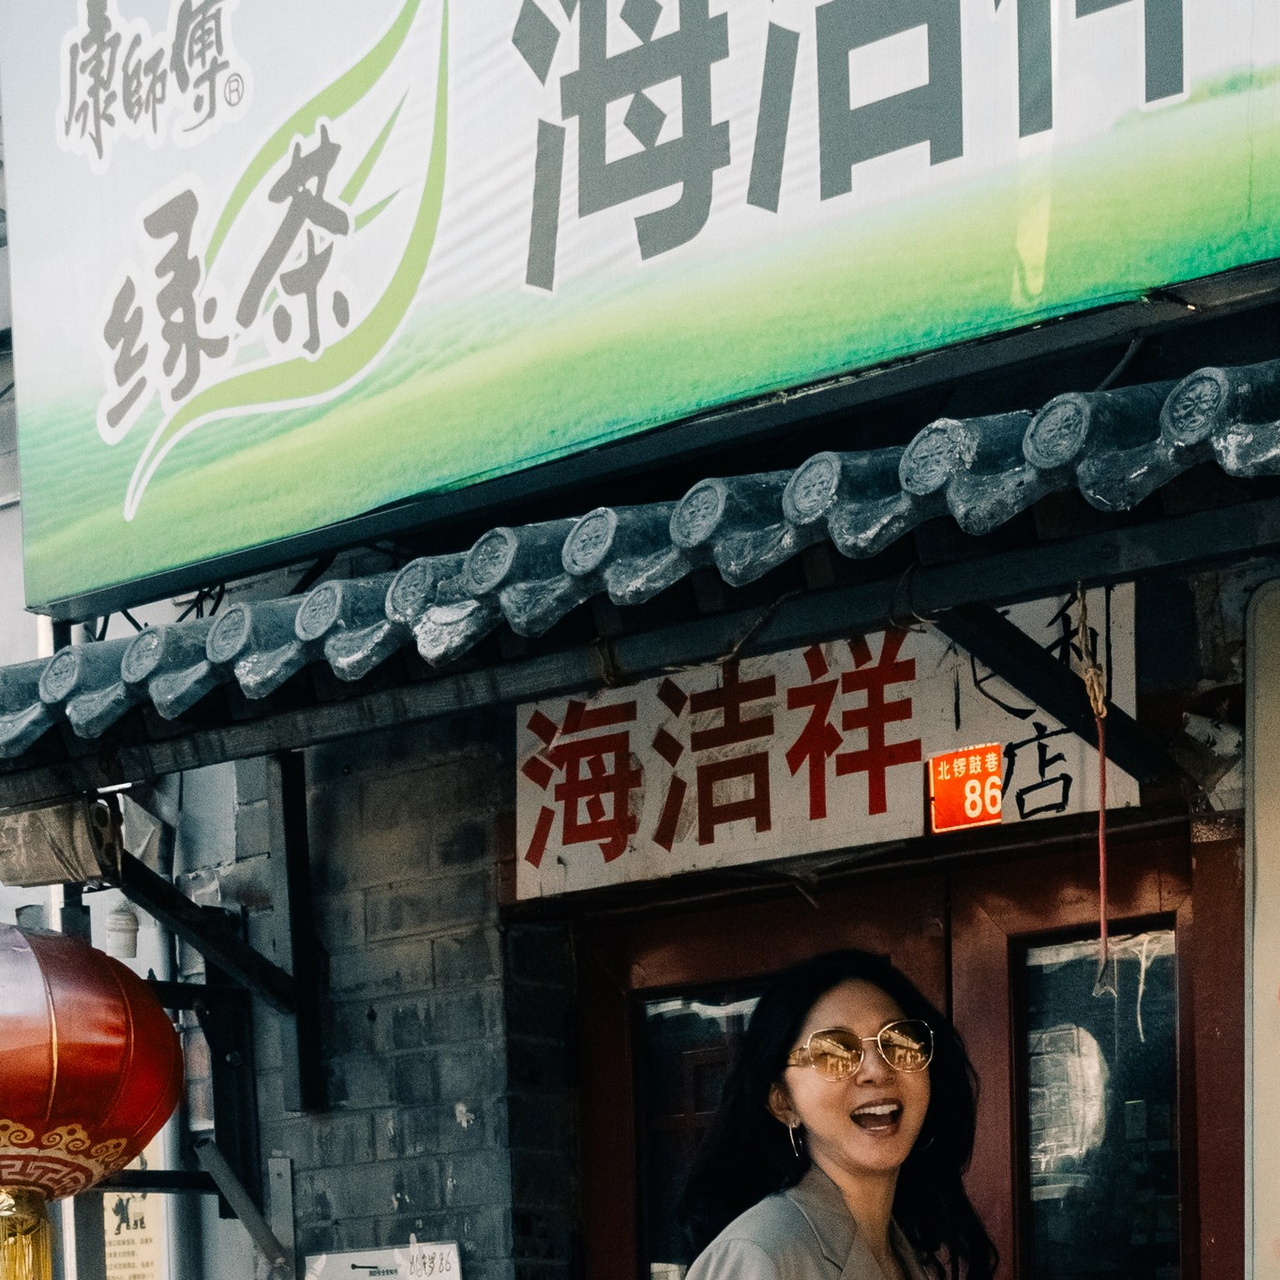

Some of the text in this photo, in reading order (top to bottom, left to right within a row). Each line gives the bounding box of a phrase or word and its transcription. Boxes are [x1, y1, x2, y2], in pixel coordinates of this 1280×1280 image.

[103, 124, 350, 428] 绿茶
[521, 624, 922, 869] 海洁祥
[938, 752, 998, 780] 北锣鼓巷
[1001, 721, 1073, 820] 店
[964, 775, 1002, 818] 86
